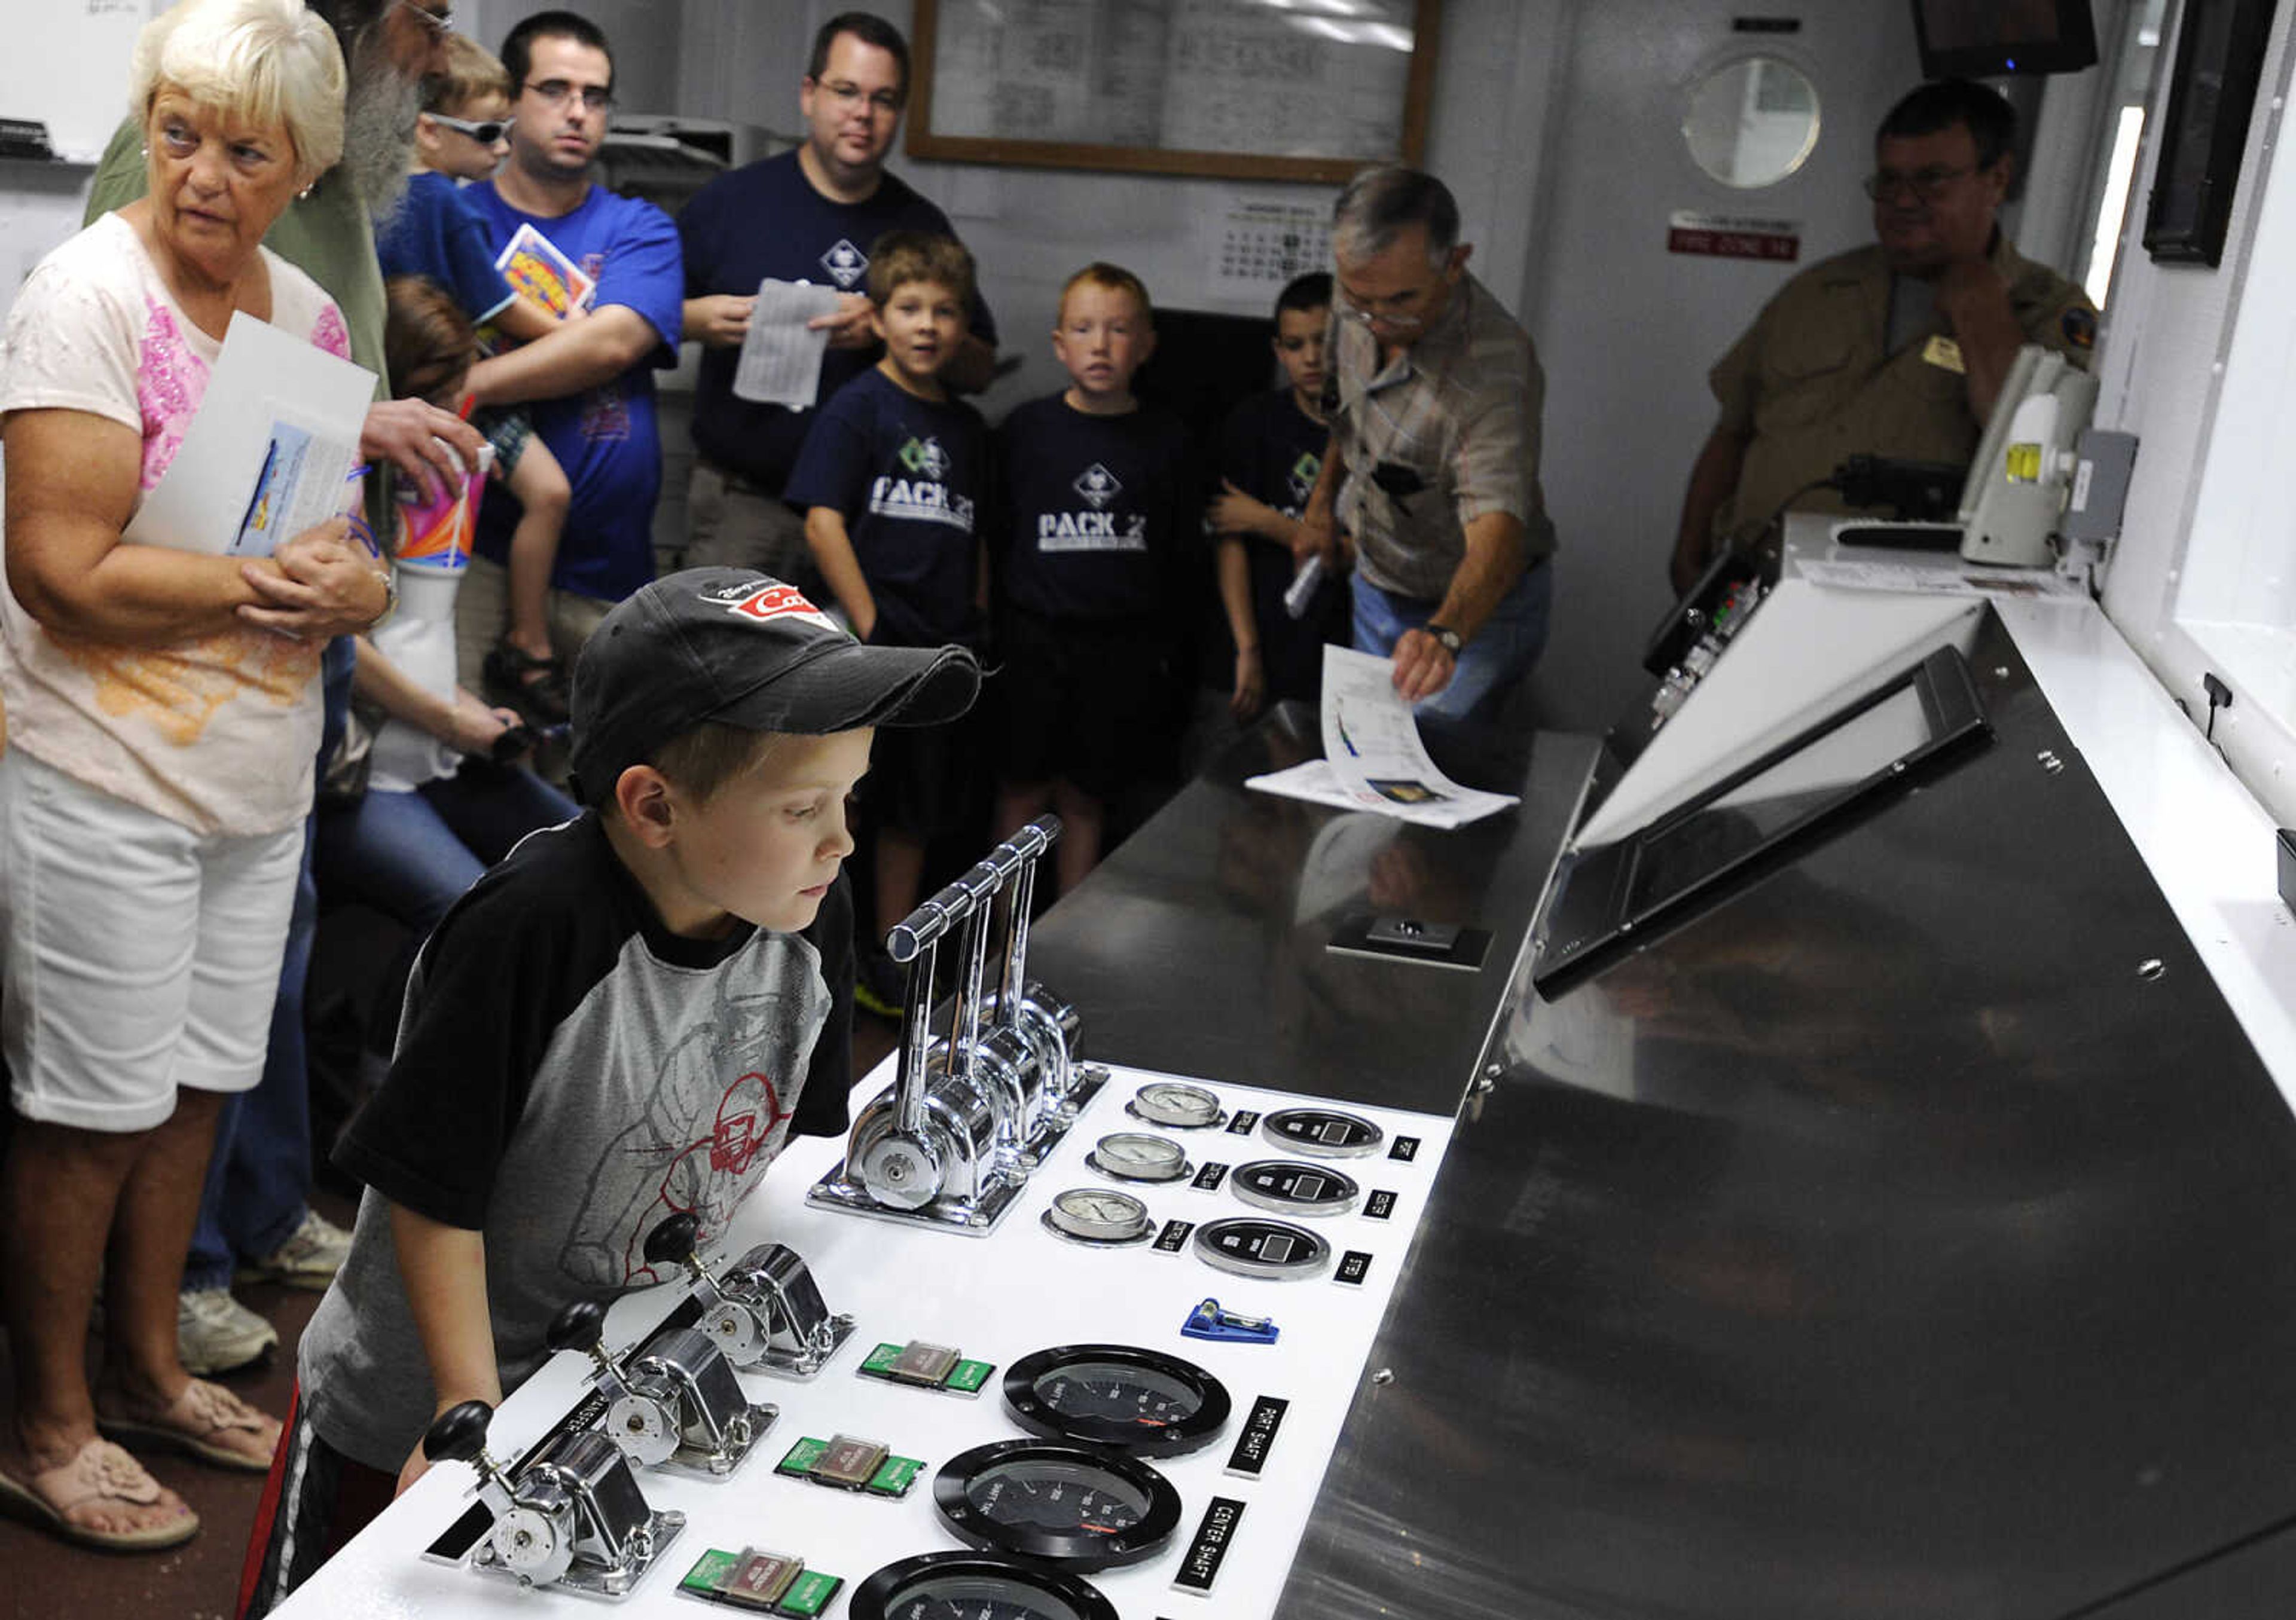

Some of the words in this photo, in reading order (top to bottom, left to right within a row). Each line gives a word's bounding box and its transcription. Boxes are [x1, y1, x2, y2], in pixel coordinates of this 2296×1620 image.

[1038, 512, 1115, 537] PACK
[1254, 1407, 1277, 1431] PORT
[1241, 1431, 1267, 1460] SHAFT
[1205, 1506, 1234, 1543] CENTER
[1189, 1544, 1217, 1579] SHAFT
